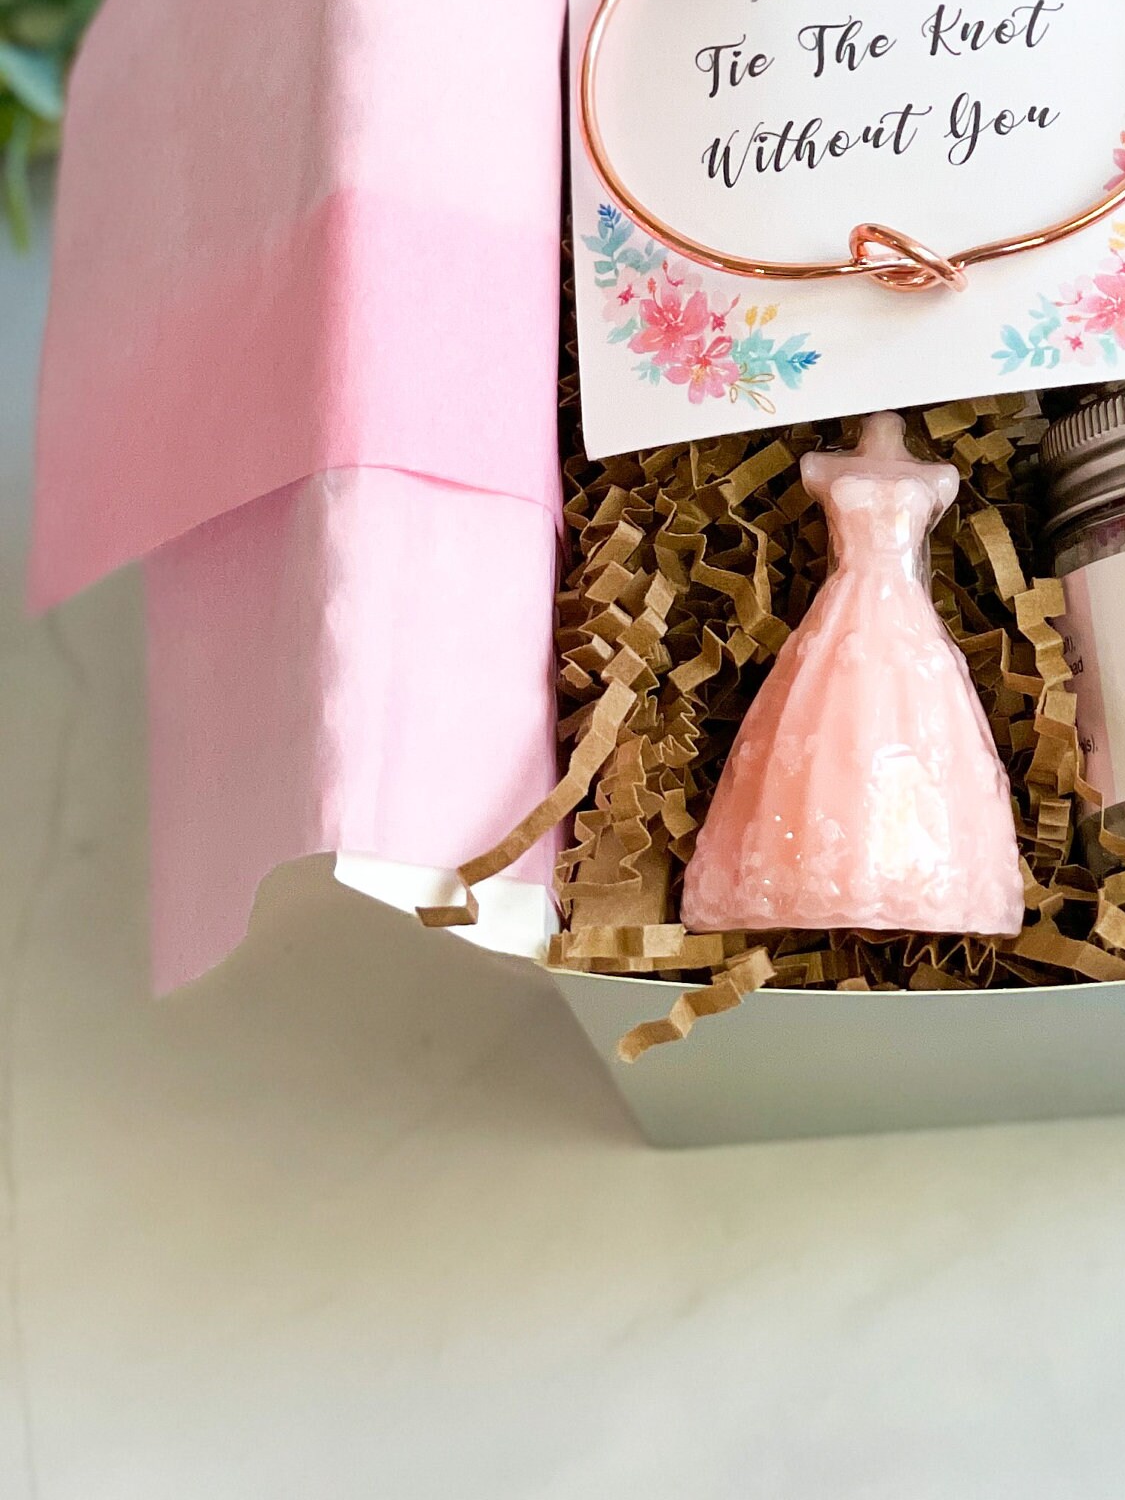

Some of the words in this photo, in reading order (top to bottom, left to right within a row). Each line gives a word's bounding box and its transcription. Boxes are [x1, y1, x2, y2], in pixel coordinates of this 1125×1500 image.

[695, 34, 773, 98] Tie
[798, 14, 897, 78] The
[921, 0, 1064, 57] Knot
[701, 103, 932, 188] Without
[944, 92, 1060, 166] You
